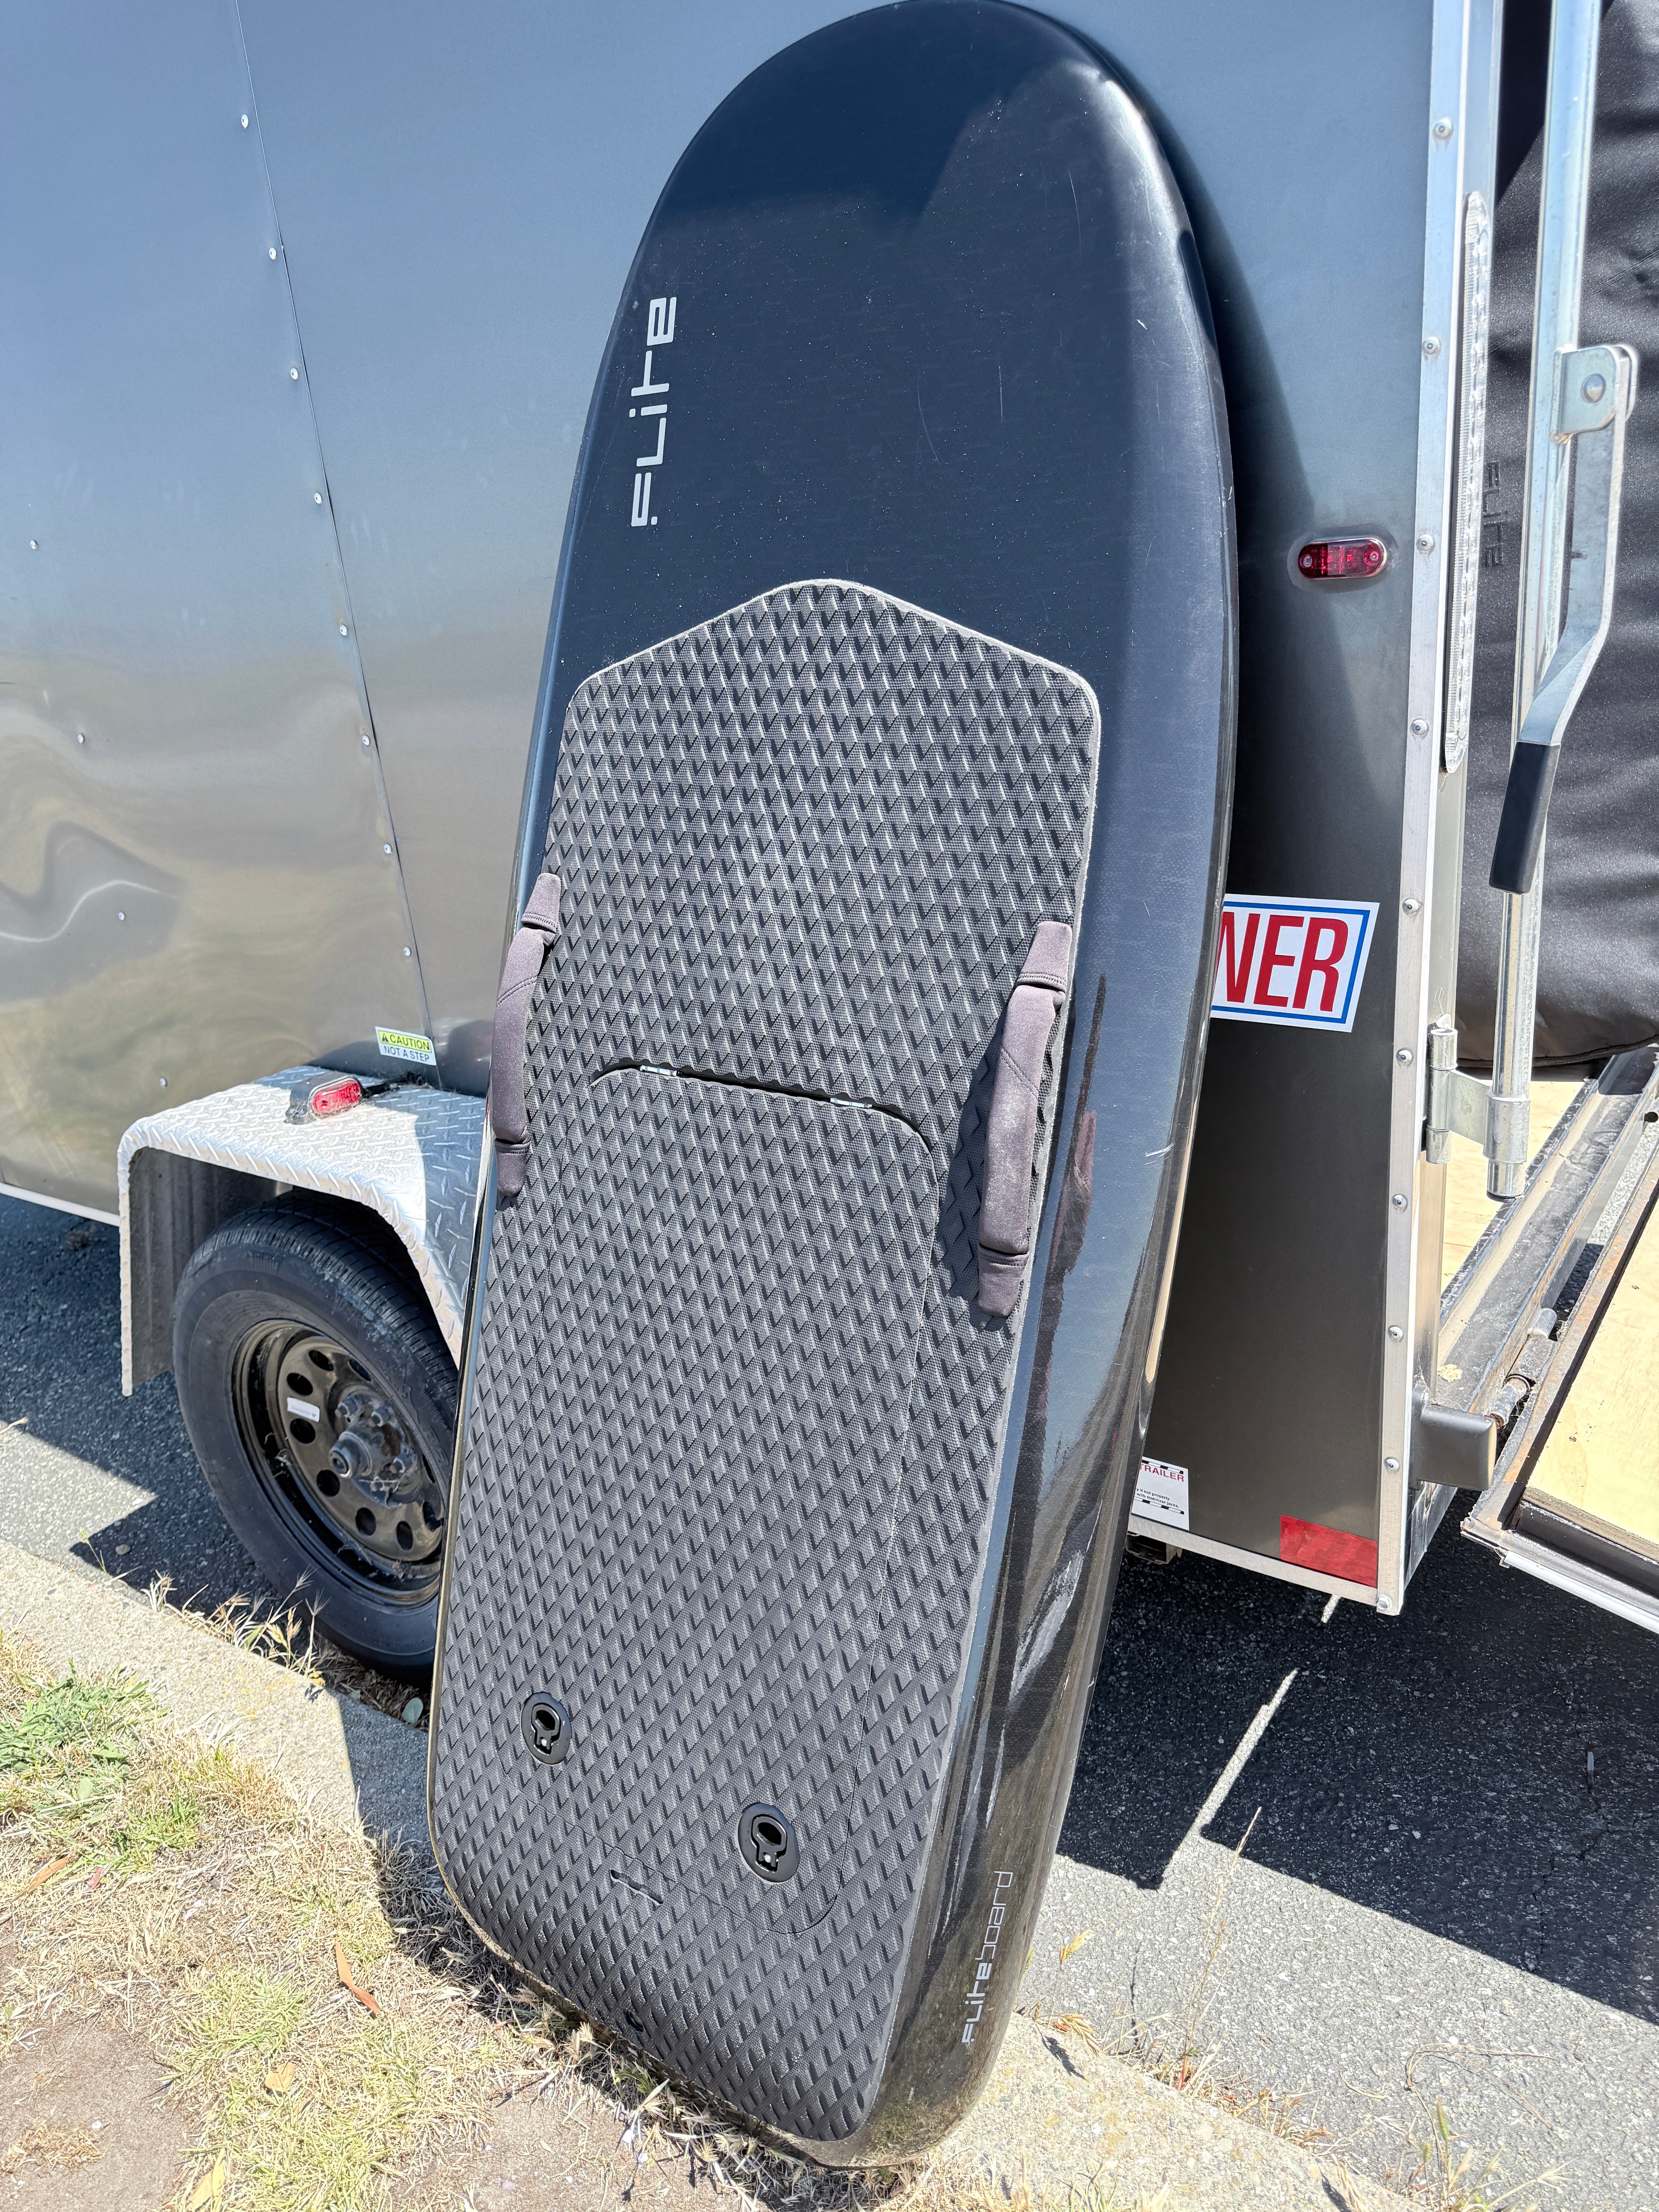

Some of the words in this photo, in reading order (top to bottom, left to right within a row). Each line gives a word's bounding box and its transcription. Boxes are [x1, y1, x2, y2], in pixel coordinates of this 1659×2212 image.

[390, 1034, 430, 1050] CAUTION
[384, 1045, 400, 1056] NOT
[403, 1049, 408, 1058] A
[410, 1051, 429, 1062] STEP
[1139, 1463, 1184, 1482] TRAILER
